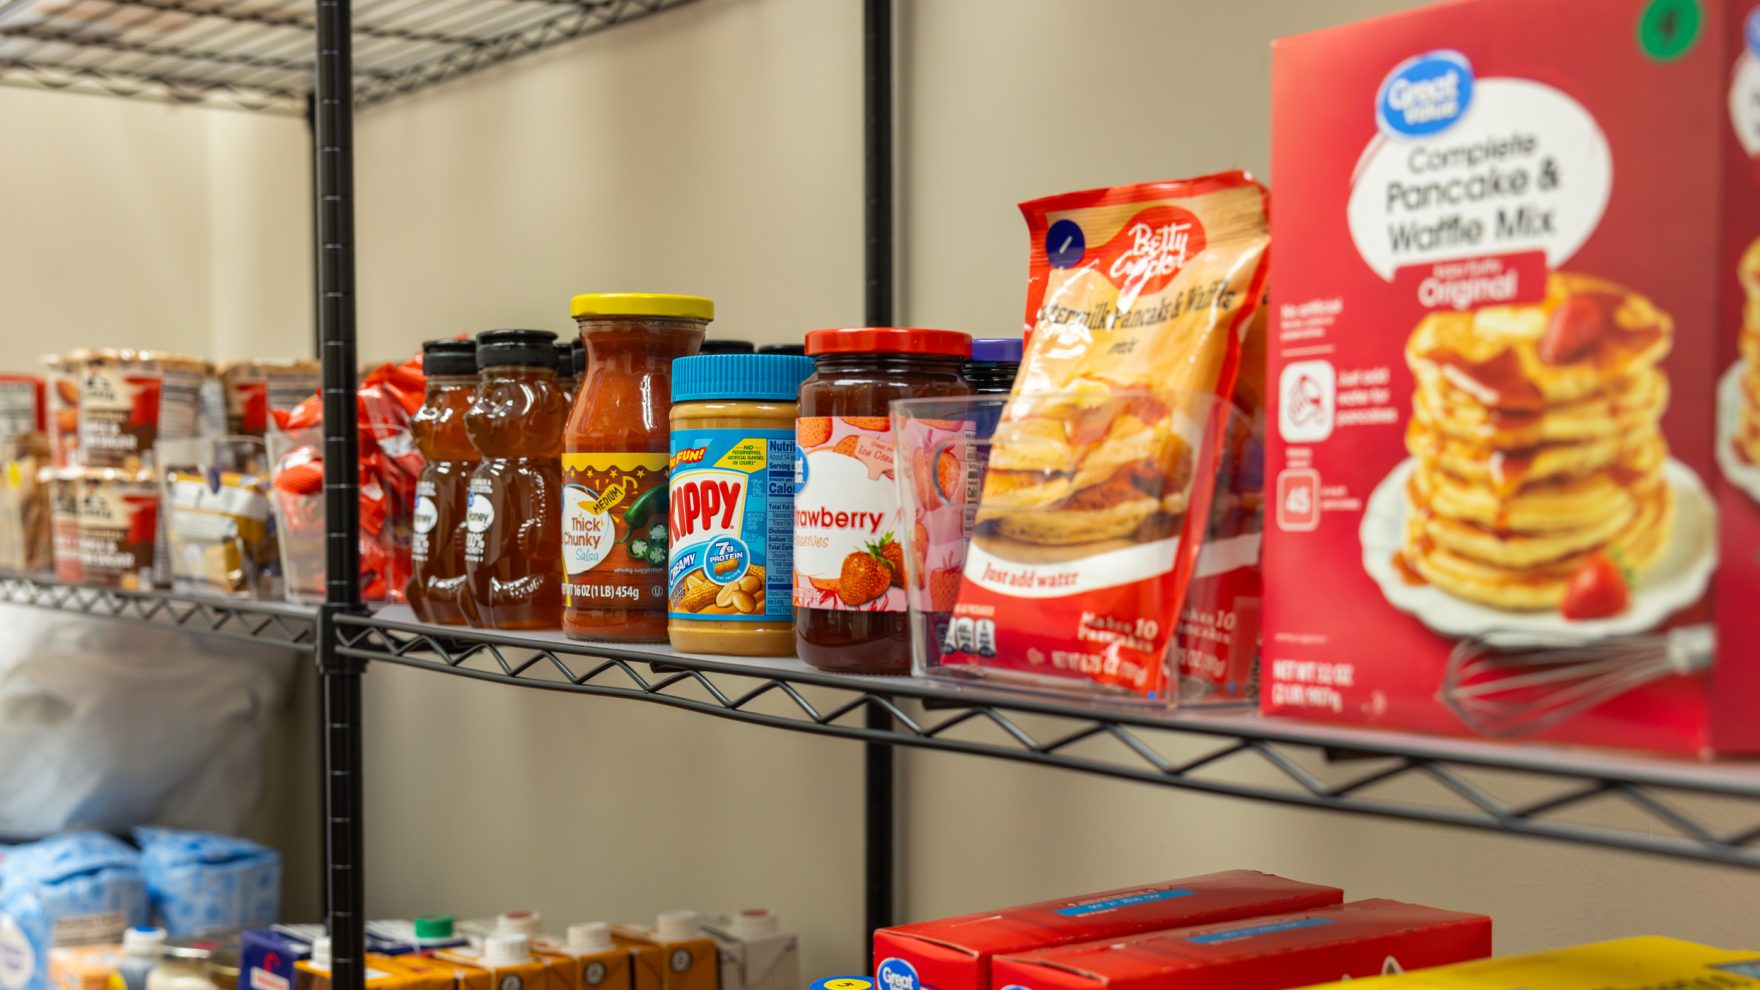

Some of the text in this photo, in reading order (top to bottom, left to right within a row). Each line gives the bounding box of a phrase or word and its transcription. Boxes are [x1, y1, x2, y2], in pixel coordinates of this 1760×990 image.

[1388, 70, 1460, 110] Great
[1404, 100, 1458, 125] Value
[1408, 132, 1538, 175] Complete
[1386, 156, 1561, 212] Pancake &
[1128, 222, 1192, 255] Betty
[1389, 204, 1556, 253] Waffle Mix
[1417, 268, 1518, 310] Original
[676, 446, 704, 465] FUN!
[769, 441, 796, 452] Nutrit
[859, 445, 872, 457] Ice
[592, 486, 623, 513] MEDIUM
[769, 483, 793, 494] Calo
[1286, 486, 1311, 514] 45
[571, 517, 601, 532] Thick
[669, 480, 741, 549] KIPPY
[563, 532, 602, 550] Chunky
[715, 541, 734, 556] 7g
[576, 548, 599, 562] Salsa
[709, 551, 743, 563] PROTEIN
[670, 552, 696, 587] CREAMY
[982, 561, 1079, 588] Just add water
[574, 585, 581, 597] 16
[581, 585, 590, 597] OZ
[591, 585, 599, 599] (1
[600, 585, 614, 599] LB)
[615, 586, 639, 600] 454g
[1135, 618, 1158, 640] 10
[1216, 610, 1237, 631] 10
[1273, 659, 1297, 681] NET
[1297, 660, 1316, 682] WT
[1333, 663, 1354, 687] OZ
[882, 966, 913, 988] Great
